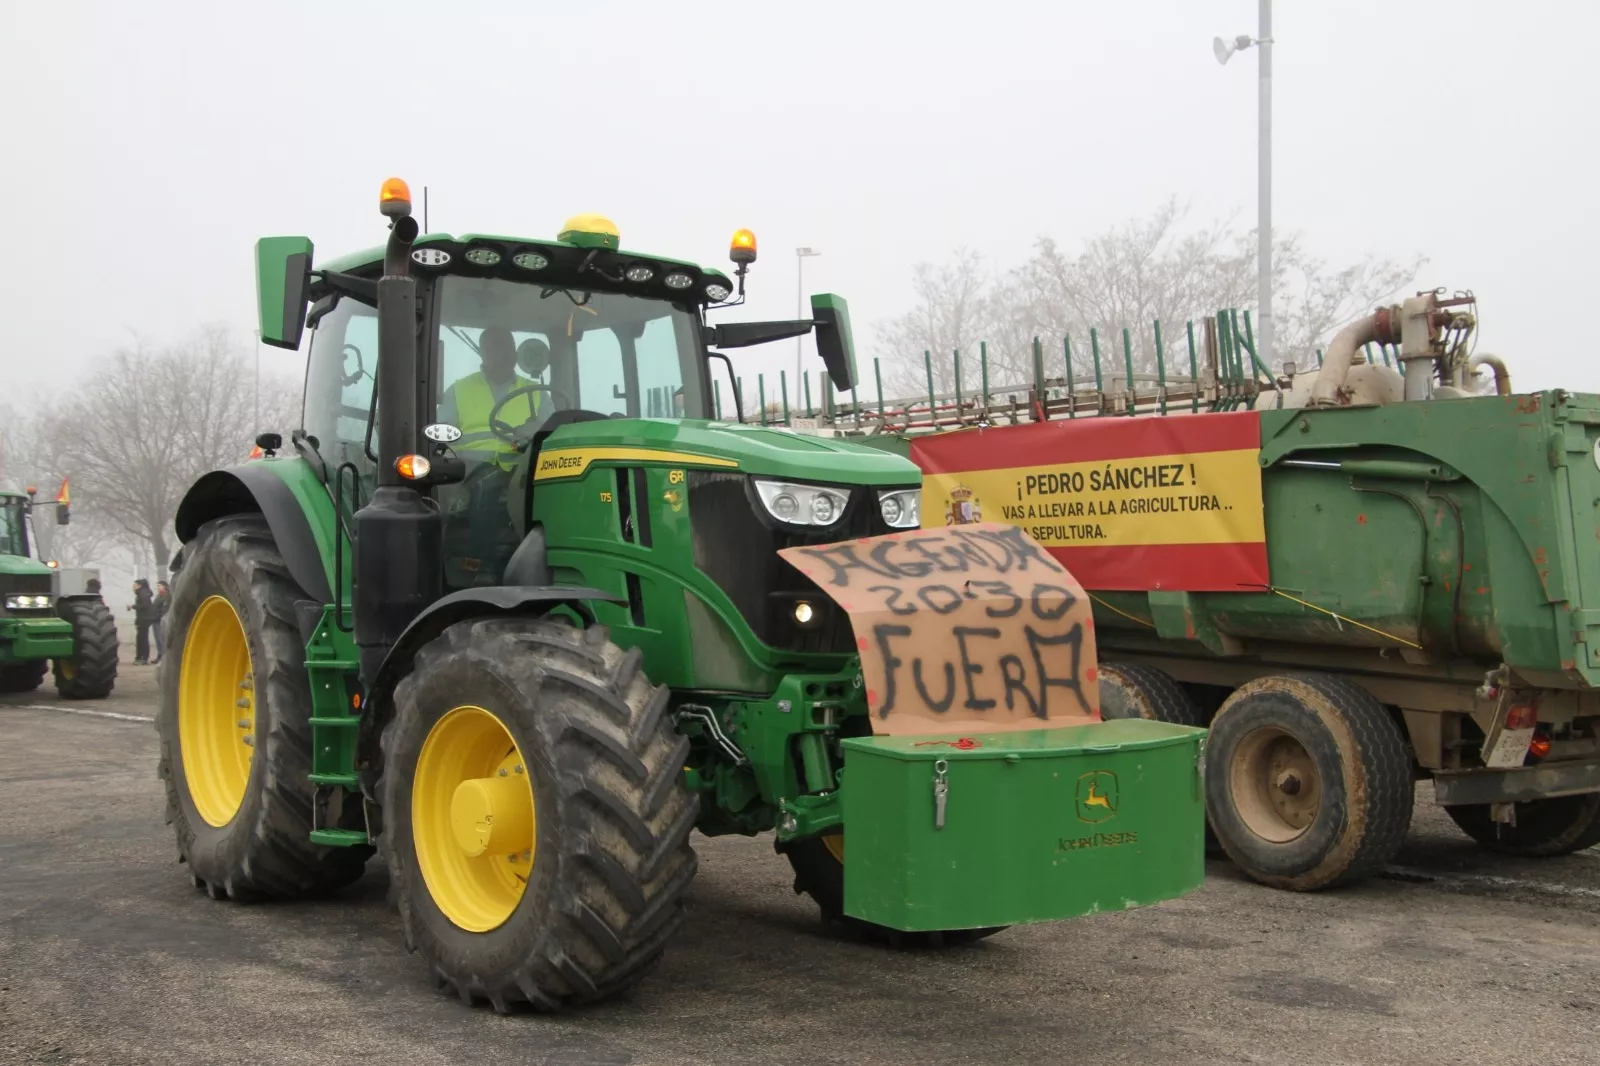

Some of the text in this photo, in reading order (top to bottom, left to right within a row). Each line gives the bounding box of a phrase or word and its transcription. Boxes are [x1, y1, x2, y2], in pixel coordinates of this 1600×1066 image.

[540, 456, 582, 471] JOHN DEERE
[669, 470, 684, 485] 6R
[600, 491, 613, 503] 175
[1002, 505, 1025, 520] VAS
[1028, 504, 1037, 519] A
[1038, 501, 1085, 518] LLEVAR
[1087, 501, 1097, 516] A
[1099, 500, 1117, 516] LA
[1032, 524, 1107, 541] SEPULTURA.
[801, 526, 1062, 587] AGENDA
[867, 580, 1077, 620] 2030
[873, 622, 1093, 720] FUERA
